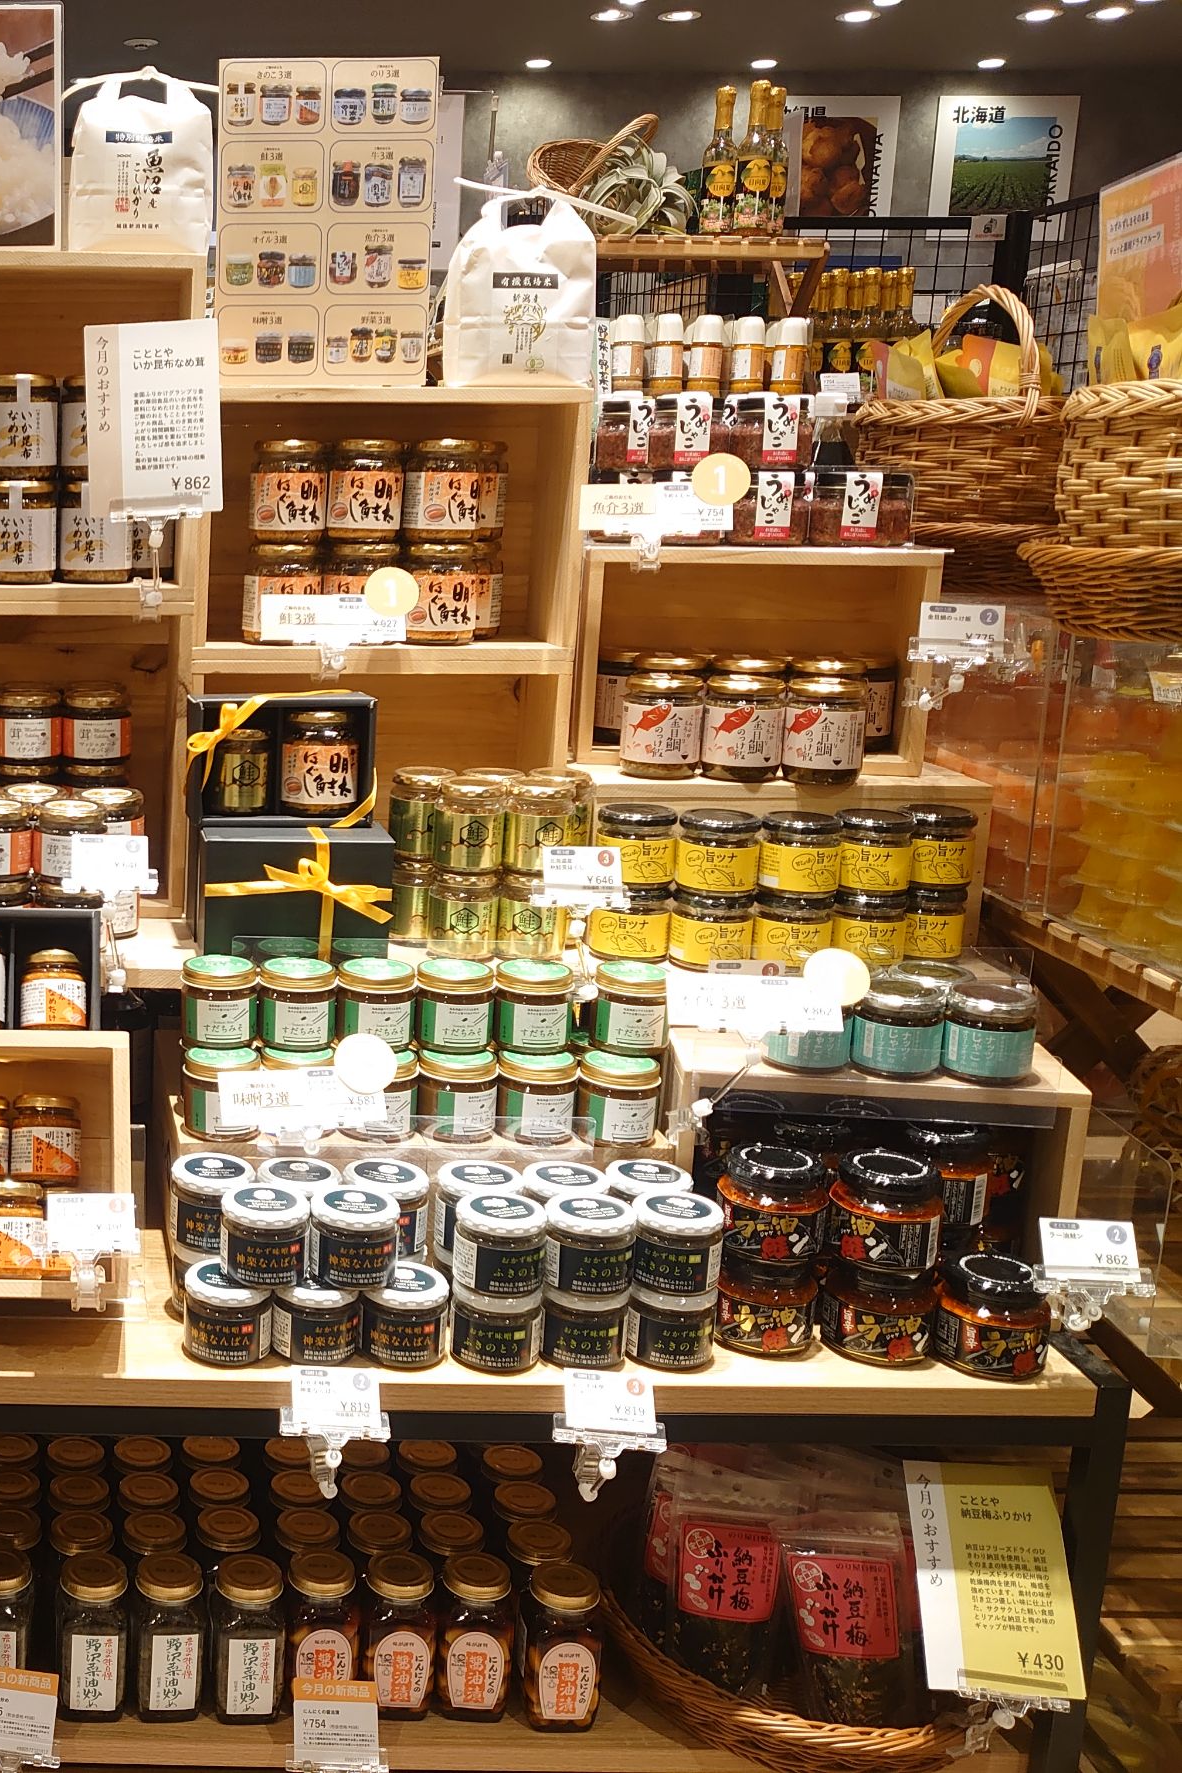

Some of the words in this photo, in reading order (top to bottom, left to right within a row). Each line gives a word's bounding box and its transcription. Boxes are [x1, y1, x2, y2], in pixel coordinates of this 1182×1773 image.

[370, 69, 400, 78] のり3選
[952, 105, 1006, 124] 北海道
[133, 347, 174, 359] こととや
[133, 357, 205, 370] いか昆布なめ茸
[96, 335, 112, 433] 今月のおすすめ
[171, 476, 211, 490] ¥862
[698, 507, 724, 517] ¥754
[667, 714, 682, 752] 金目鯛
[748, 715, 765, 756] 金目鯛
[642, 843, 669, 856] 旨ツナ
[705, 849, 737, 864] 旨ツナ
[587, 876, 614, 885] ¥646
[203, 1023, 242, 1036] すだちみそ
[283, 1023, 322, 1036] すだちみそ
[1112, 1229, 1122, 1241] 2
[1095, 1253, 1129, 1266] ¥862
[638, 1258, 694, 1277] ふきのとう
[463, 1338, 519, 1353] ふきのとう
[959, 1495, 1000, 1506] こととや
[960, 1508, 1033, 1522] 納豆梅ふりかけ
[916, 1473, 944, 1588] 今月のおすすめ
[707, 1540, 729, 1611] ふりかけ
[730, 1546, 753, 1612] 納豆梅
[816, 1571, 839, 1648] ふりかけ
[843, 1578, 869, 1647] 納豆梅
[1017, 1652, 1065, 1671] ¥430
[413, 1654, 425, 1694] にんにくの
[486, 1655, 499, 1695] にんにくの
[301, 1683, 370, 1698] 今月の新商品
[302, 1718, 326, 1730] ¥754
